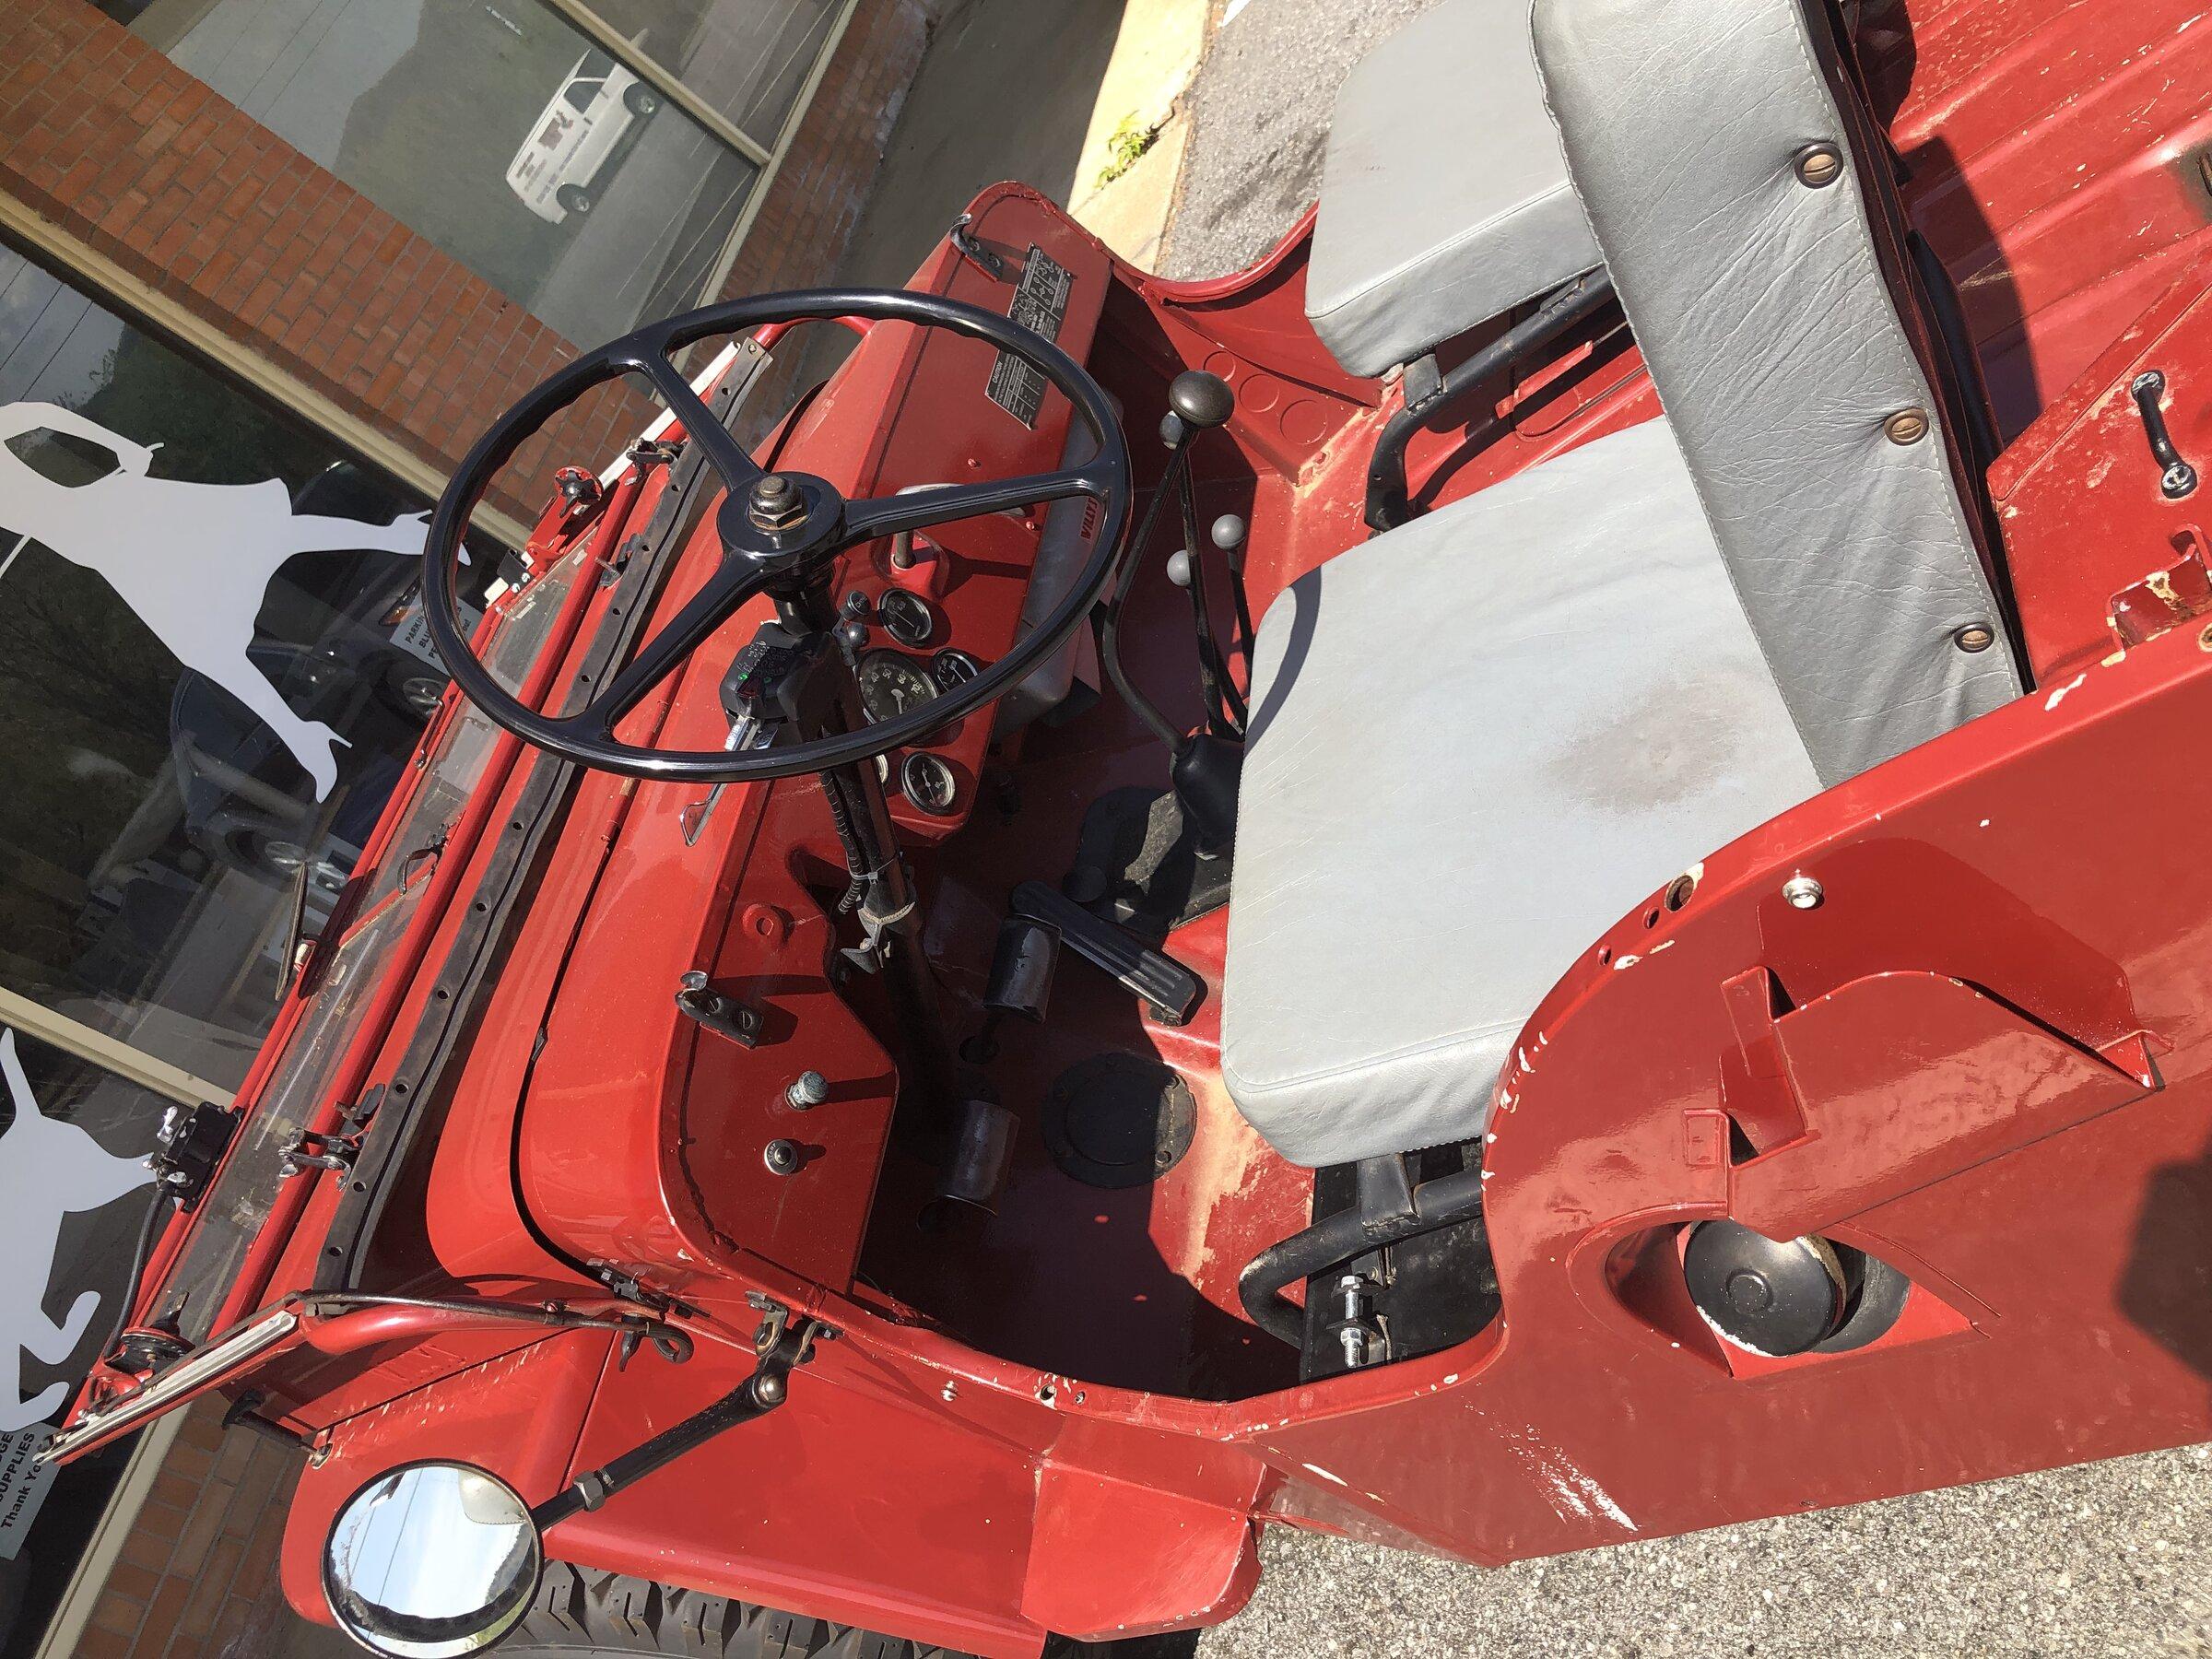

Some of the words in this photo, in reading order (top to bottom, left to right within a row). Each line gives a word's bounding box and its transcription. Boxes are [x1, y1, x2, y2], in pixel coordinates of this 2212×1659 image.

[992, 360, 1003, 383] CAUTION
[1080, 498, 1097, 539] WILLYS
[406, 612, 425, 644] PARKIN
[870, 672, 879, 683] 40
[882, 668, 892, 679] 50
[897, 673, 906, 685] 60
[911, 683, 923, 695] 70
[1, 1486, 31, 1528] Thank
